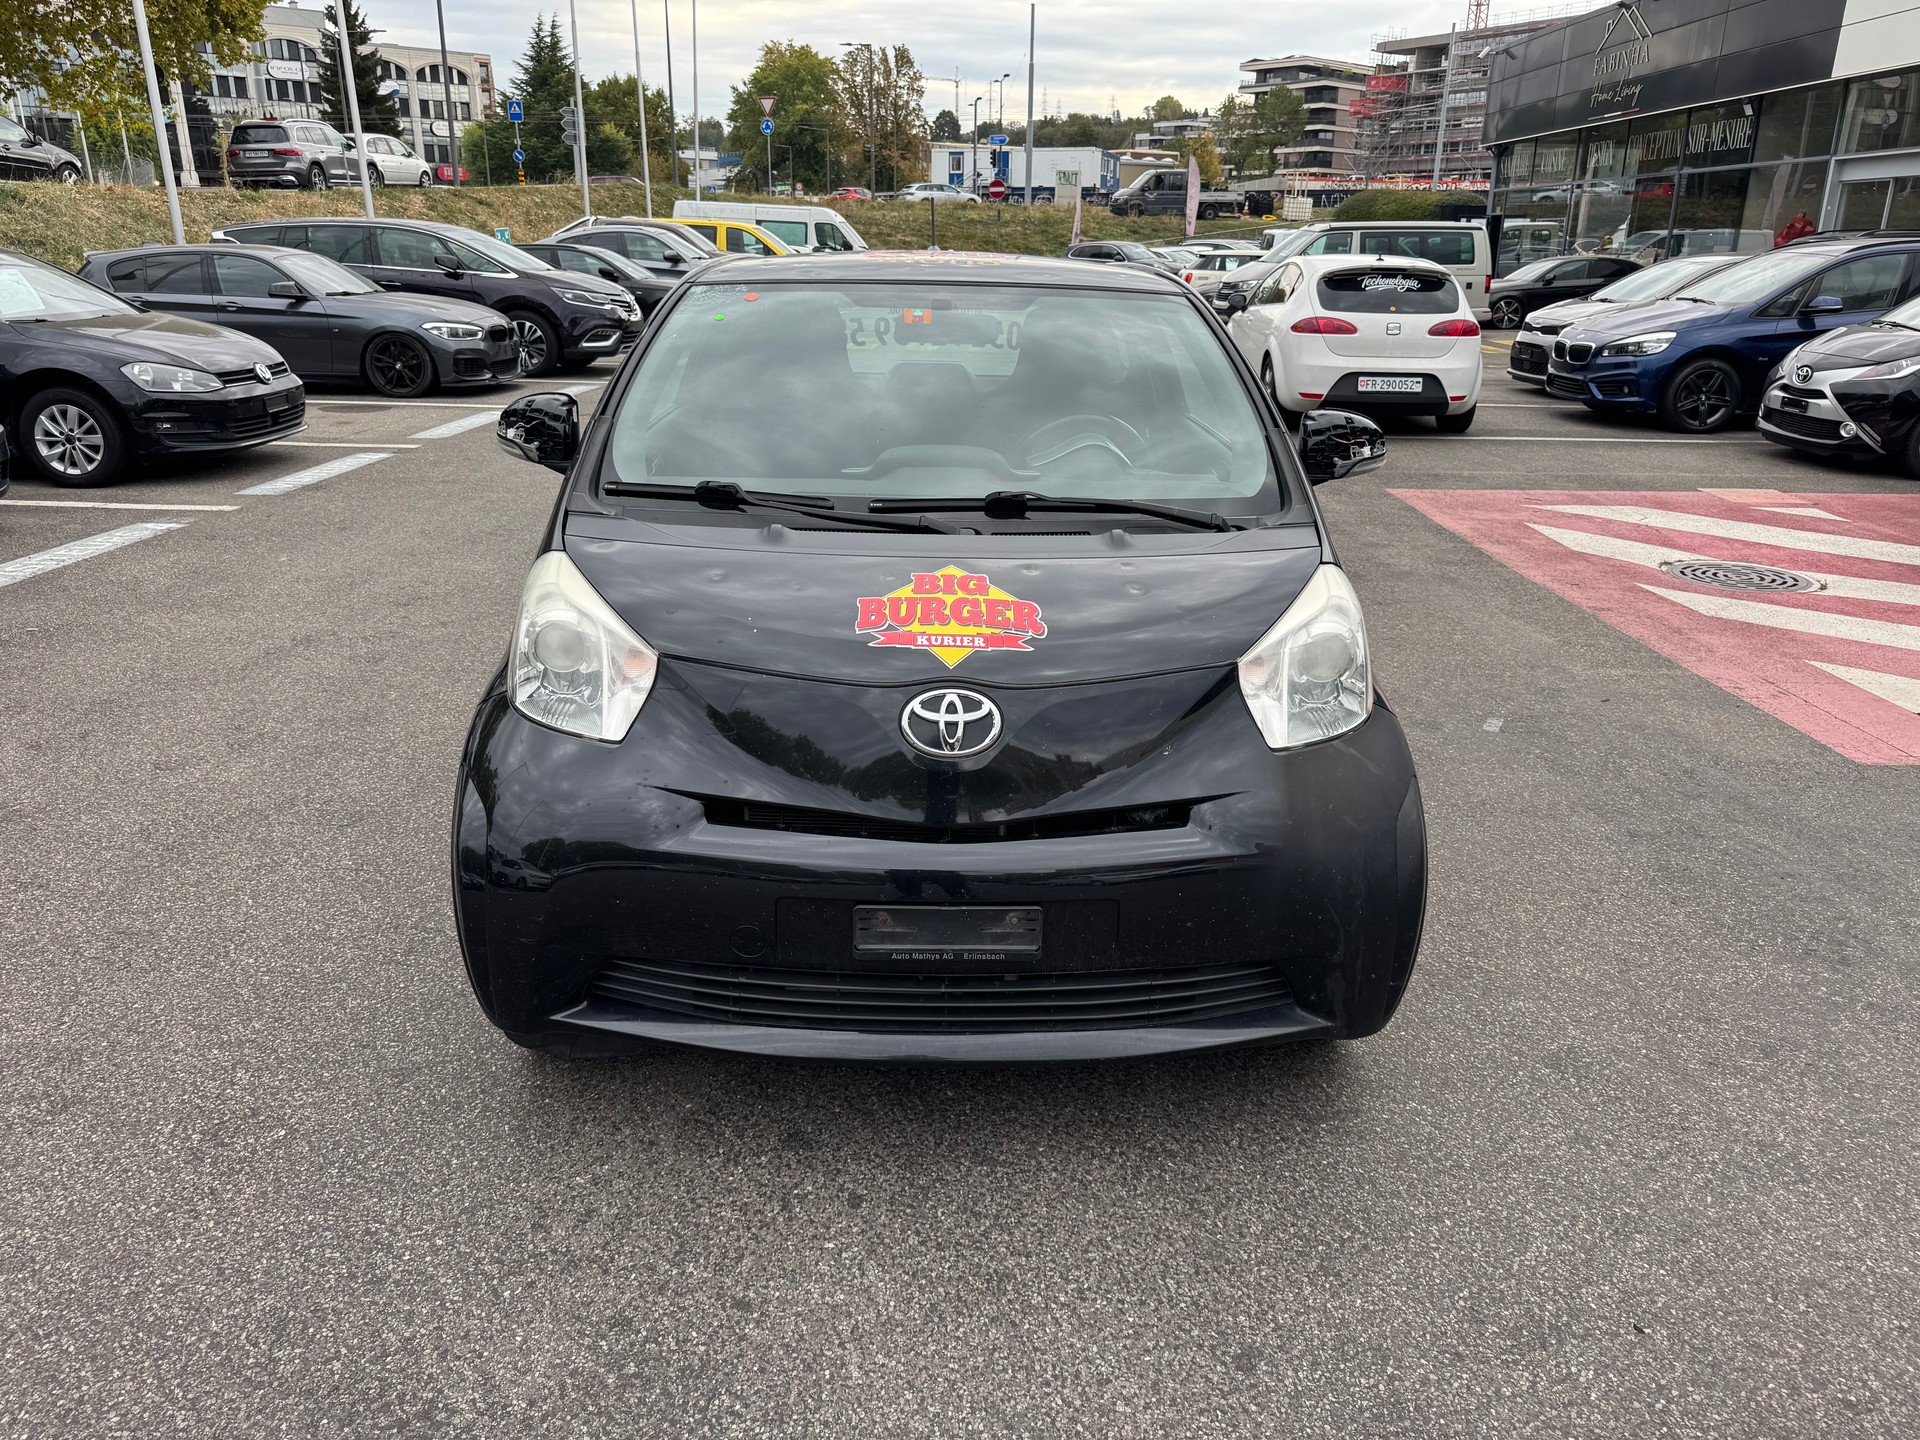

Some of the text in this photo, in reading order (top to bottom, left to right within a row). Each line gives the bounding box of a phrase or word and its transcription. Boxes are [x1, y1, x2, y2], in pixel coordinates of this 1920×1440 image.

[1593, 44, 1650, 76] FABINHA
[1590, 74, 1643, 108] Home Living
[1587, 140, 1615, 168] DESIGN
[1627, 128, 1684, 162] CONCEPTION
[1686, 117, 1754, 154] SUR-MESURE
[1357, 274, 1421, 293] Techonologia
[911, 573, 991, 596] BIG
[855, 596, 1045, 635] BURGER
[916, 635, 986, 647] KURIER
